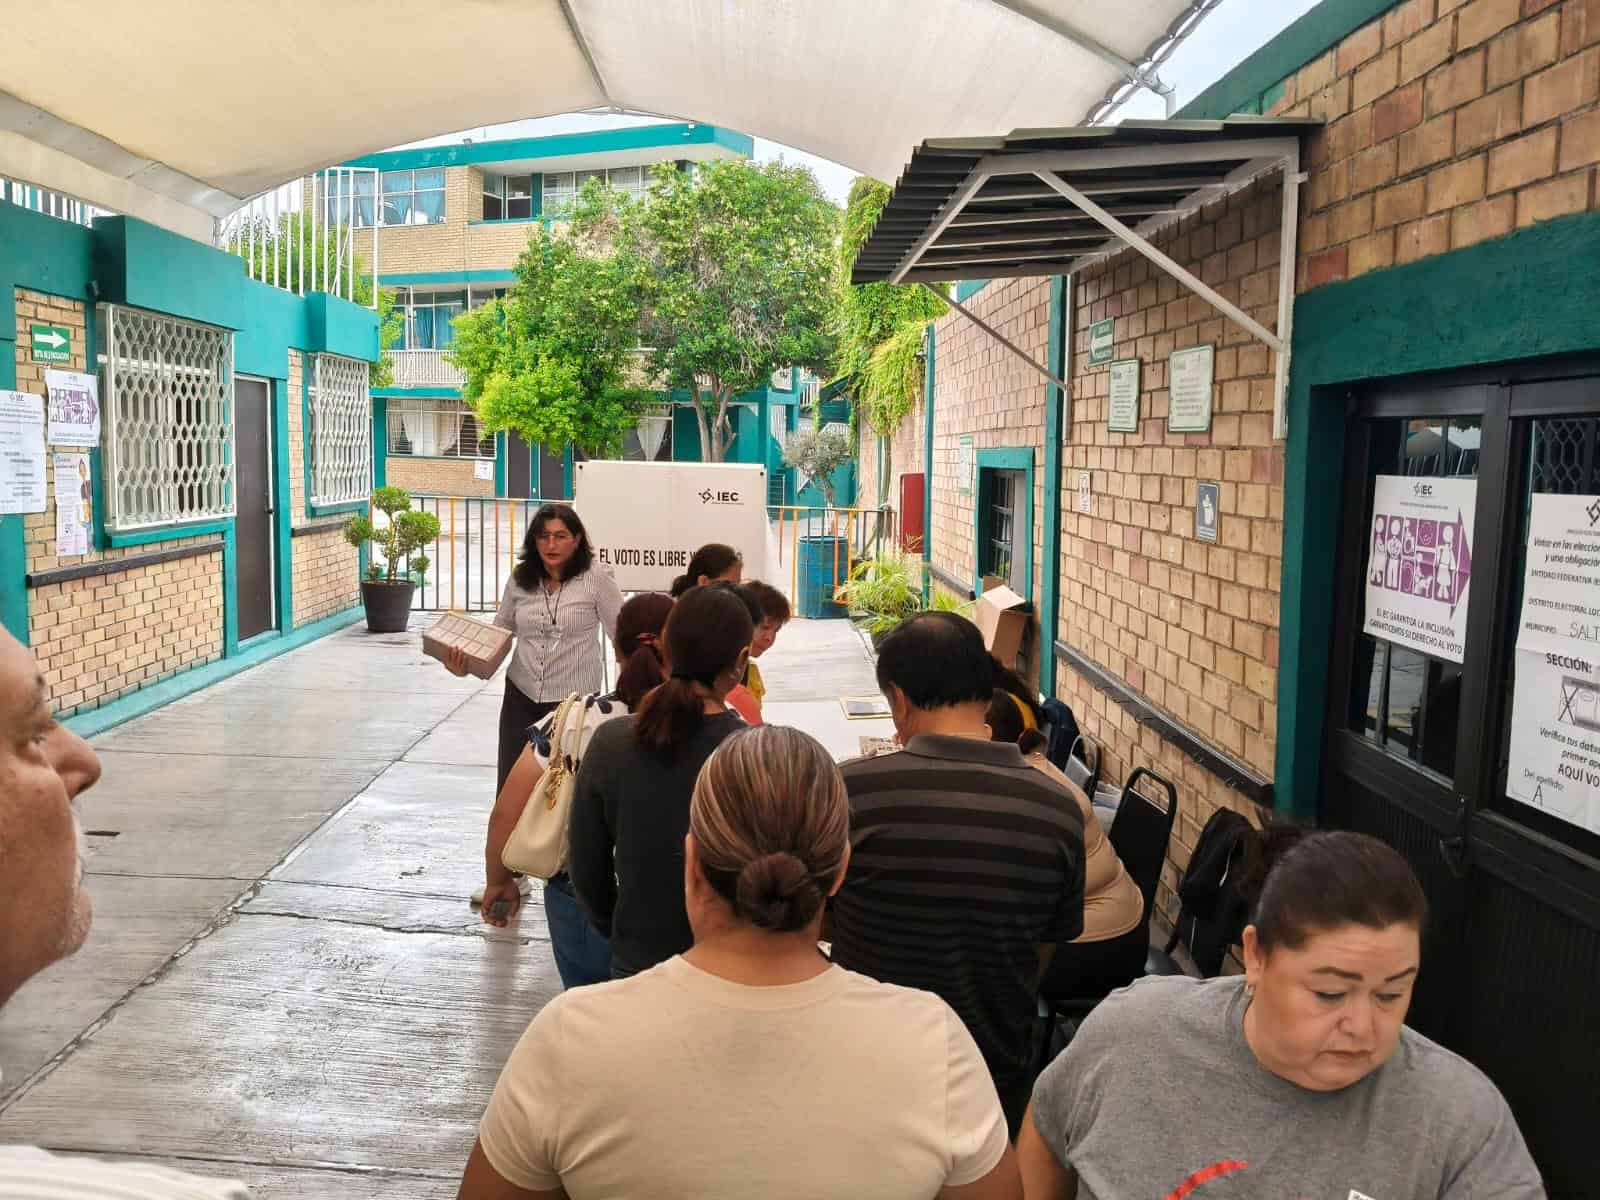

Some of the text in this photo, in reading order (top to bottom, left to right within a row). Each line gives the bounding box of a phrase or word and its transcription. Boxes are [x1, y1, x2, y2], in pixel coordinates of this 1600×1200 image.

[717, 491, 739, 502] IEC
[599, 548, 612, 565] EL
[614, 548, 640, 566] VOTO
[643, 550, 656, 566] ES
[658, 550, 687, 567] LIBRE
[1528, 597, 1554, 609] DISTRITO
[1540, 727, 1566, 743] Verifica
[1586, 772, 1600, 788] VO
[1532, 784, 1544, 807] A
